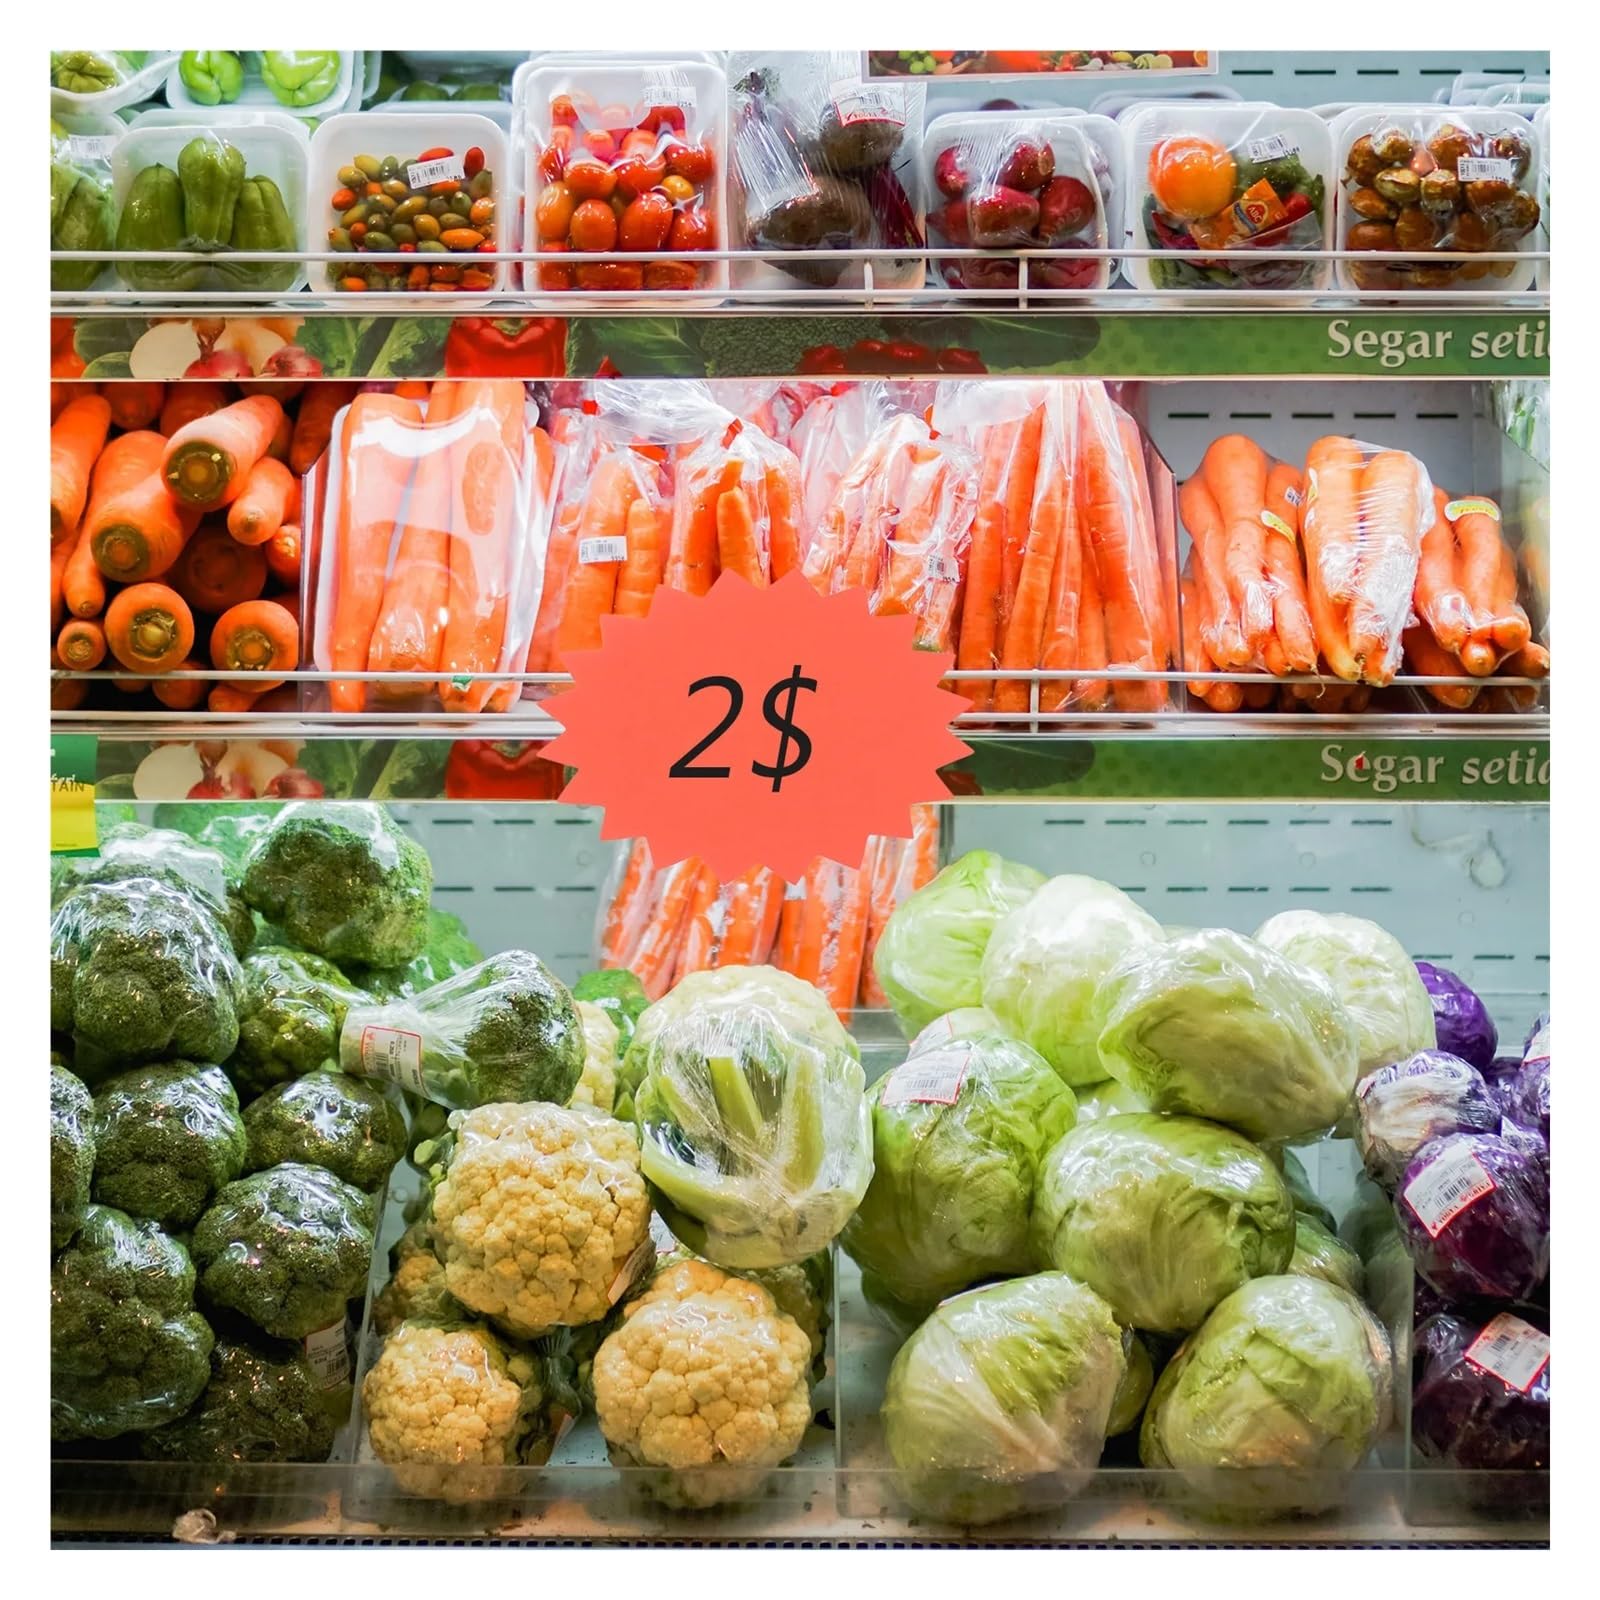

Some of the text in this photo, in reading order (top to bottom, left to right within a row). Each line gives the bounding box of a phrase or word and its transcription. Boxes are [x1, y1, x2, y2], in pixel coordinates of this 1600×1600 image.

[1247, 206, 1263, 223] ABC
[1328, 319, 1550, 368] Segar seti
[1320, 744, 1444, 793] Segar
